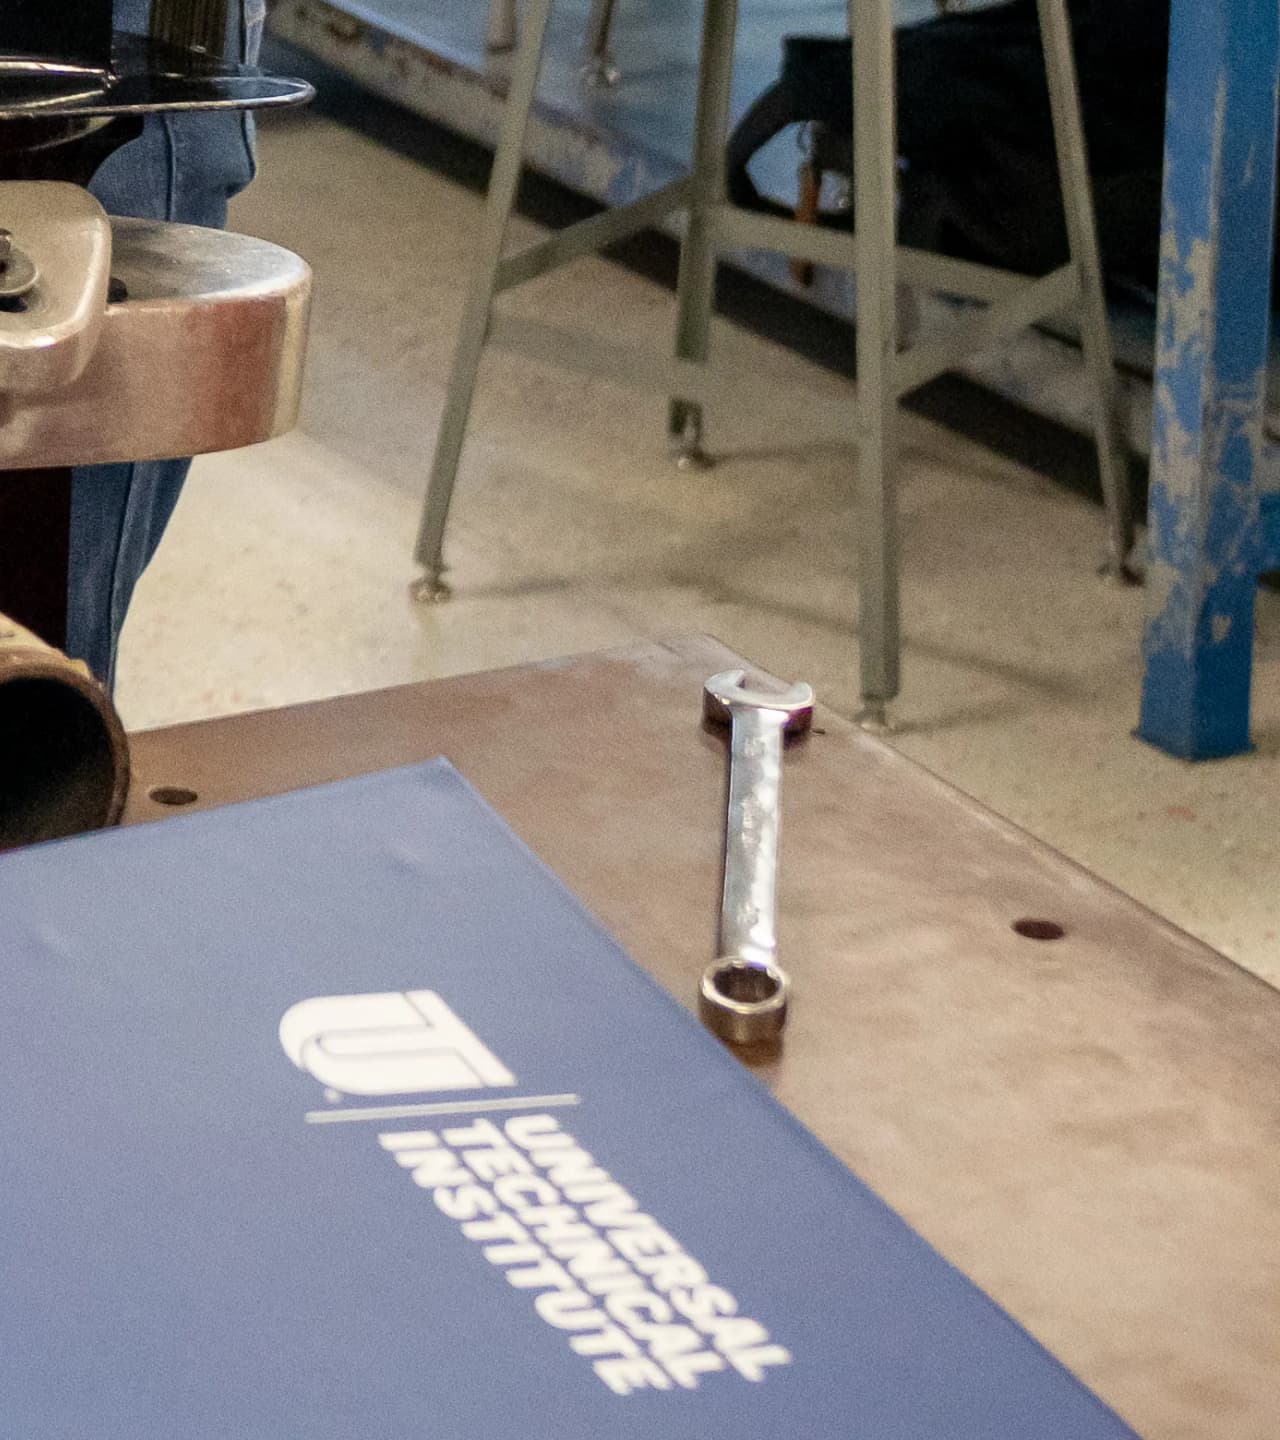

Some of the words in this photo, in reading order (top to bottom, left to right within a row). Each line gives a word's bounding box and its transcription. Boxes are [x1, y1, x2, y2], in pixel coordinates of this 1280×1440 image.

[377, 1129, 674, 1397] INSTITUTE
[439, 1117, 726, 1391] TECHNICAL
[503, 1112, 793, 1383] UNIVERSAL
